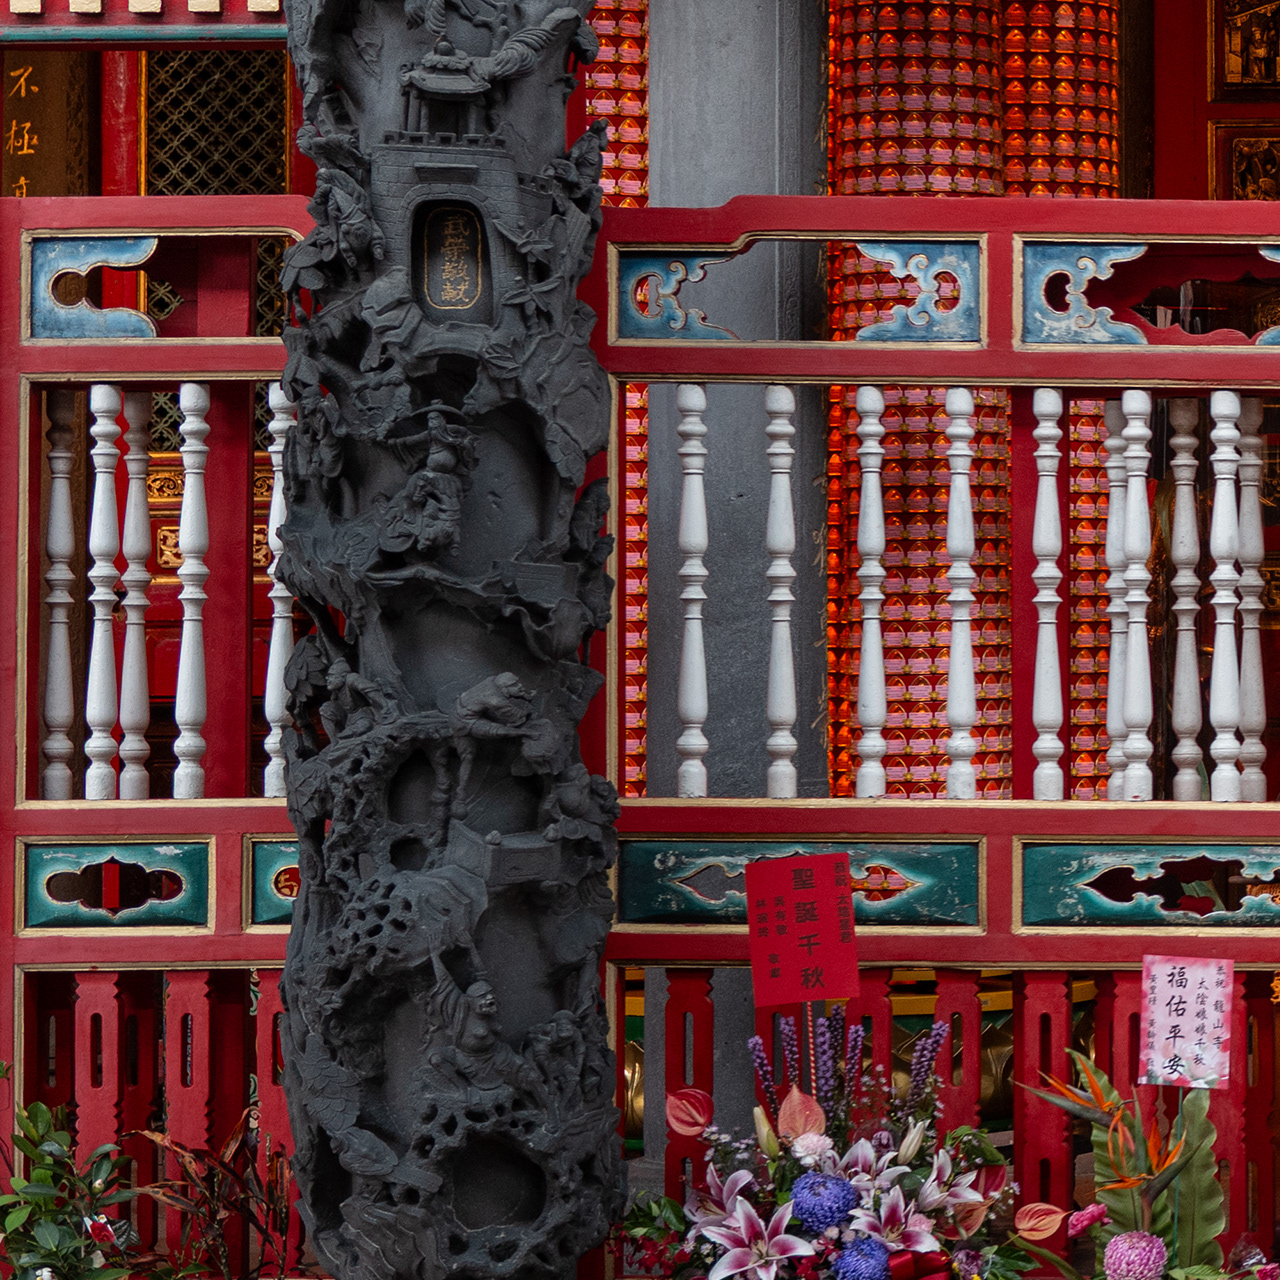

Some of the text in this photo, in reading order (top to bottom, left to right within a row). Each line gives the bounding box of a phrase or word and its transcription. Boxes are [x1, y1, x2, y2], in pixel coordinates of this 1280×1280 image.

[791, 867, 825, 990] 聖誕千秋
[1162, 965, 1188, 1076] 福佑平安
[1212, 1000, 1225, 1049] 龍山寺
